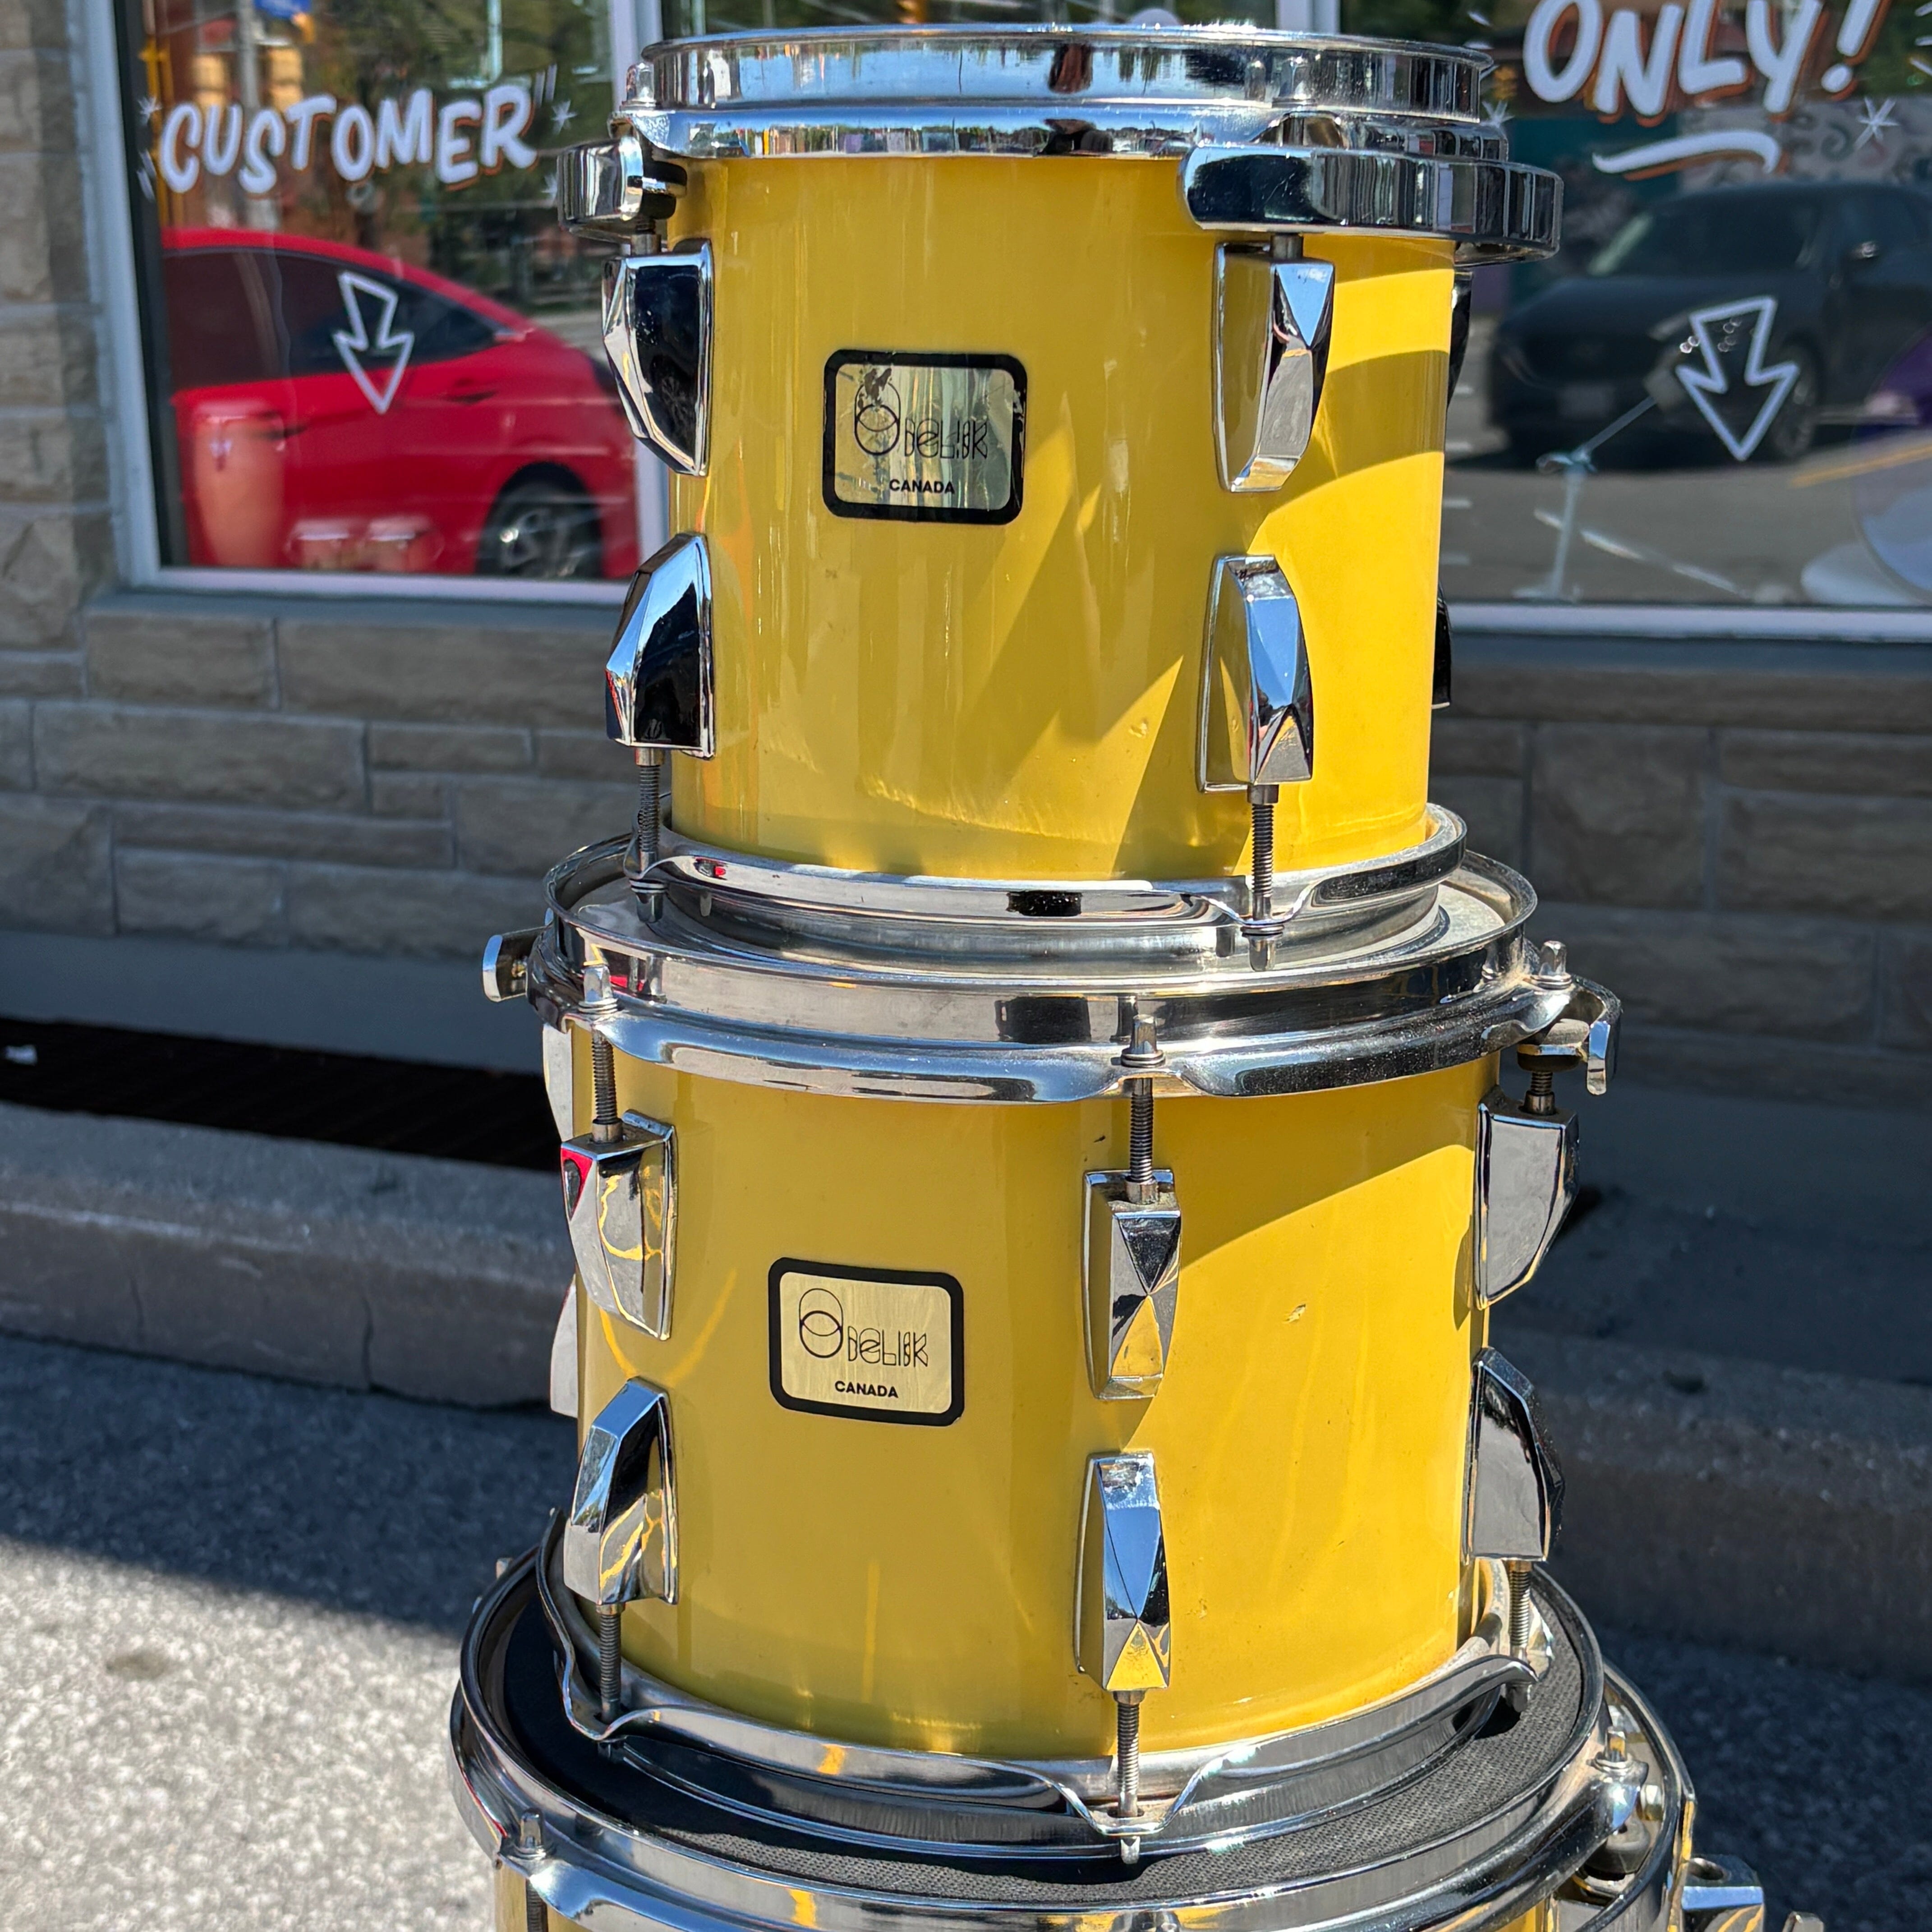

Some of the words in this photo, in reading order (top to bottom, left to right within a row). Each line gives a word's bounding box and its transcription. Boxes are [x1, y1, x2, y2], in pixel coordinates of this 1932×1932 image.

[1523, 0, 1881, 116] ONLY!
[160, 85, 538, 193] CUSTOMER
[889, 478, 955, 494] CANADA
[834, 1380, 899, 1398] CANADA
